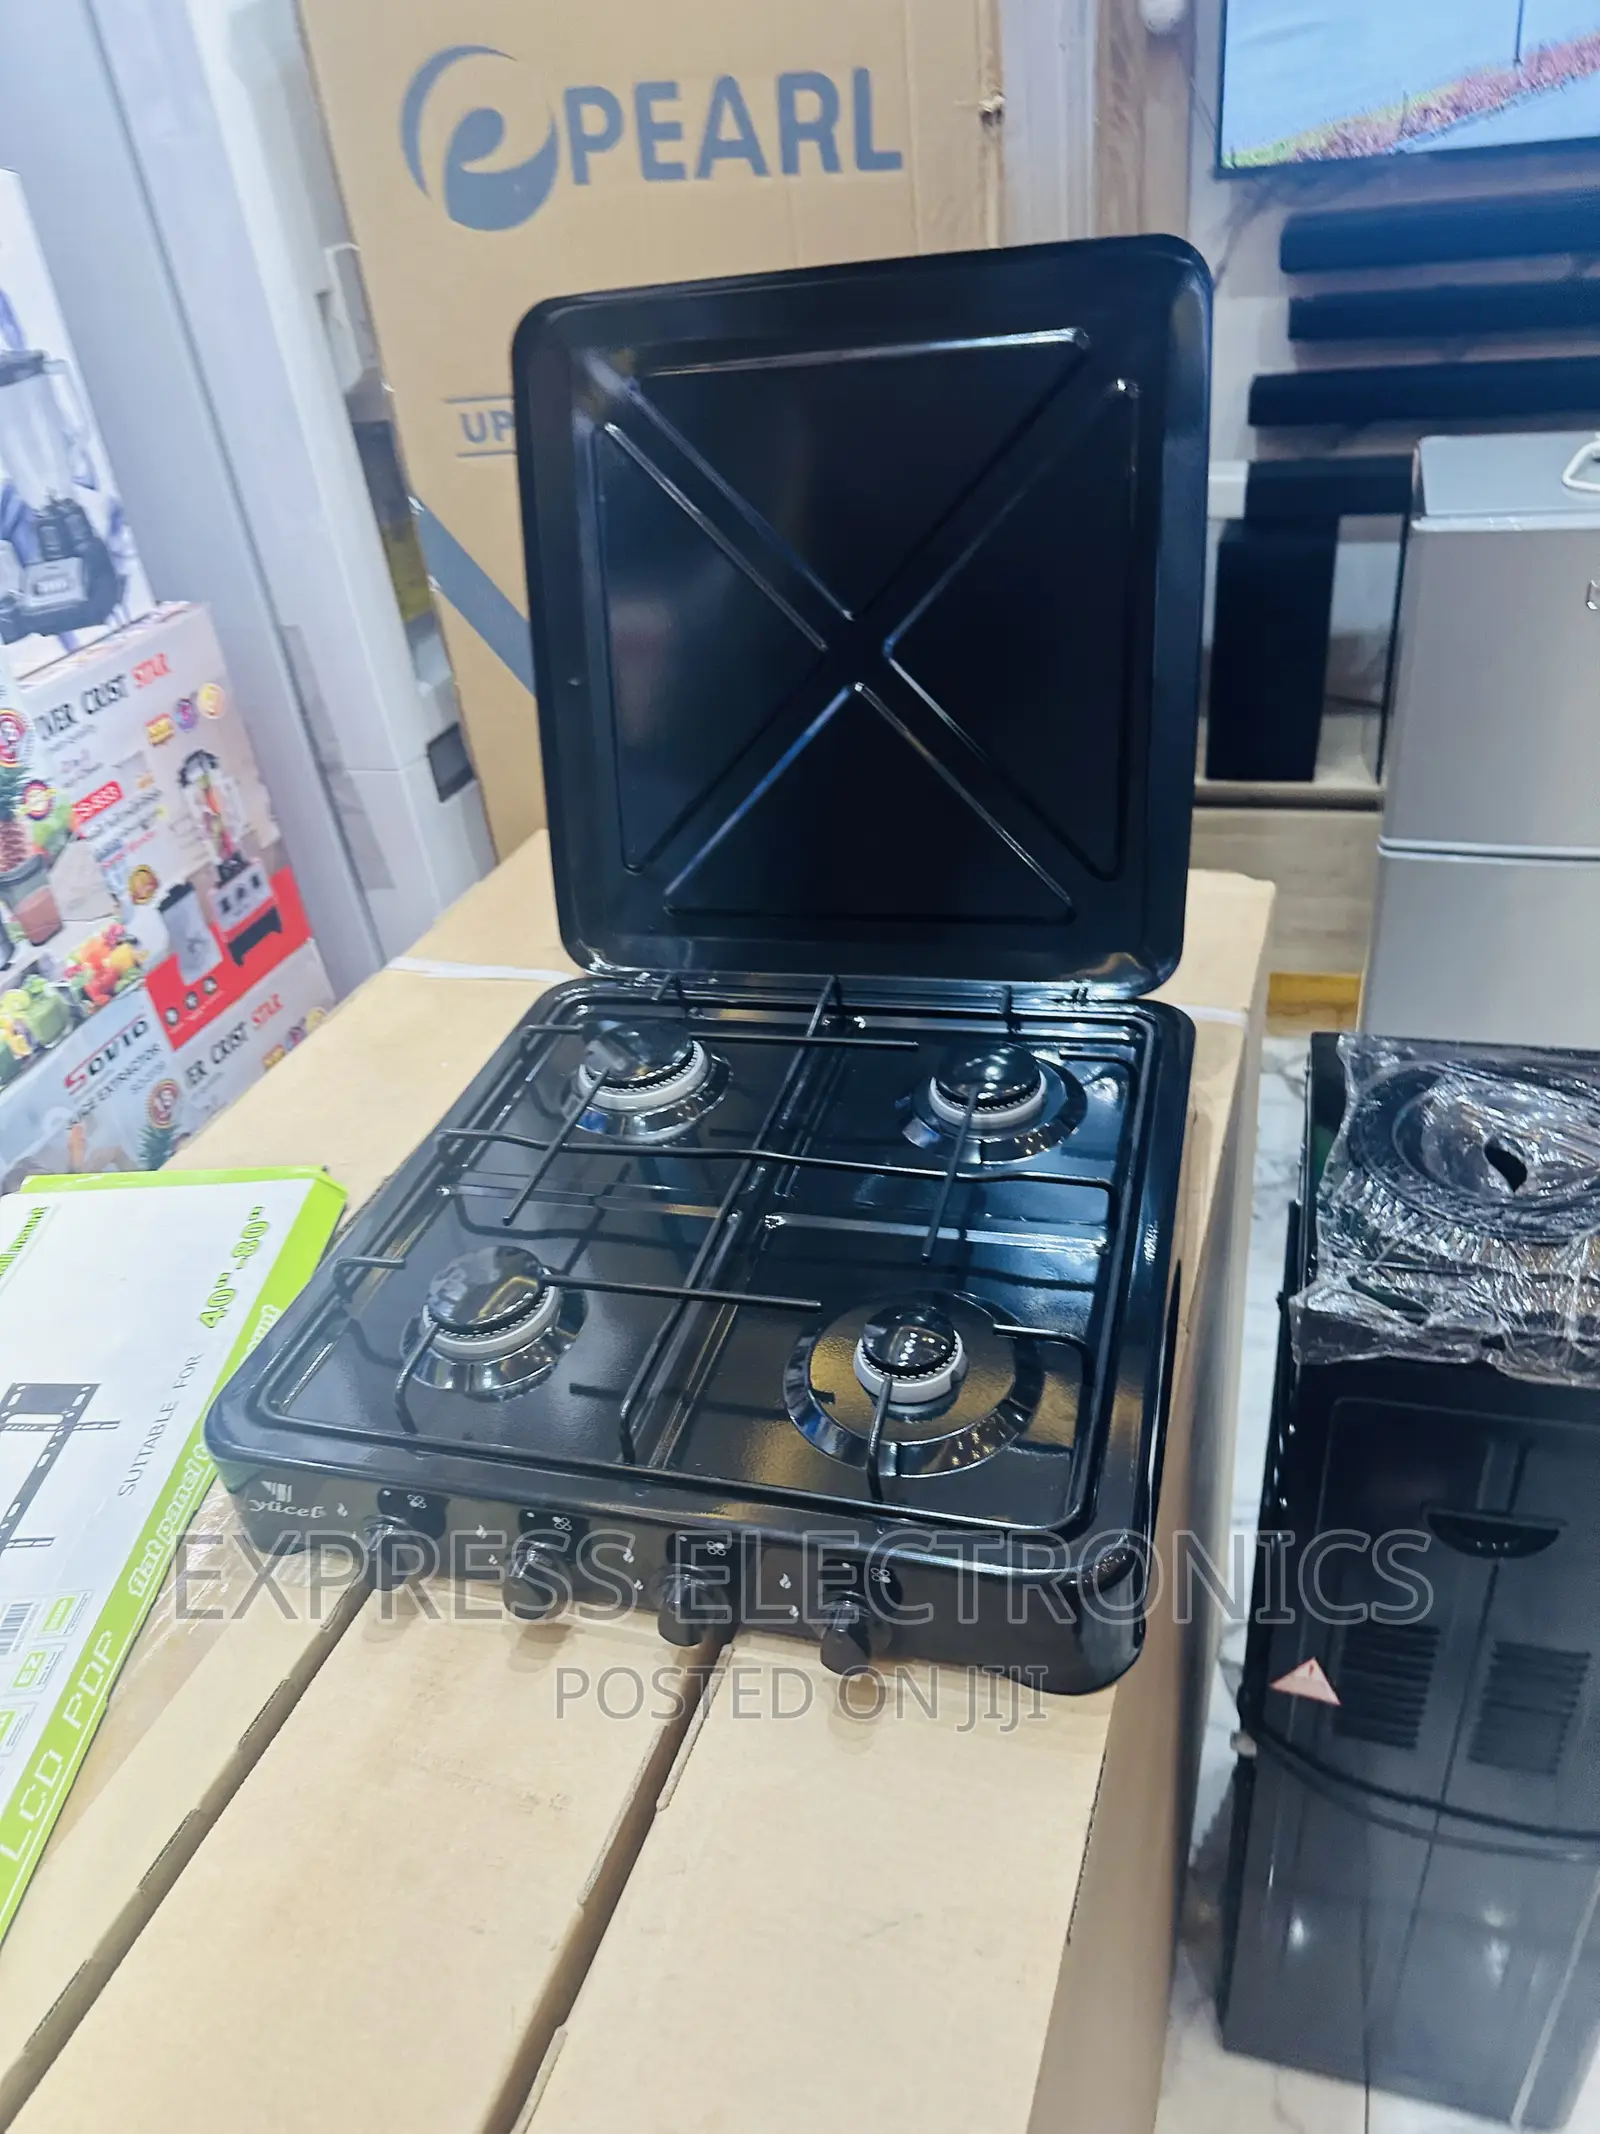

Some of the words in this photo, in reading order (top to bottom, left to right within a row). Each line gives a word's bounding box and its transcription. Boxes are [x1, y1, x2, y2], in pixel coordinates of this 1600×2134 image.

[563, 67, 903, 186] PEARL
[117, 1401, 179, 1497] SUITABLE
[172, 1352, 204, 1390] FOR
[127, 1539, 163, 1598] flat
[156, 1457, 205, 1545] panel
[0, 1749, 63, 1862] LCD
[62, 1629, 113, 1730] PDP
